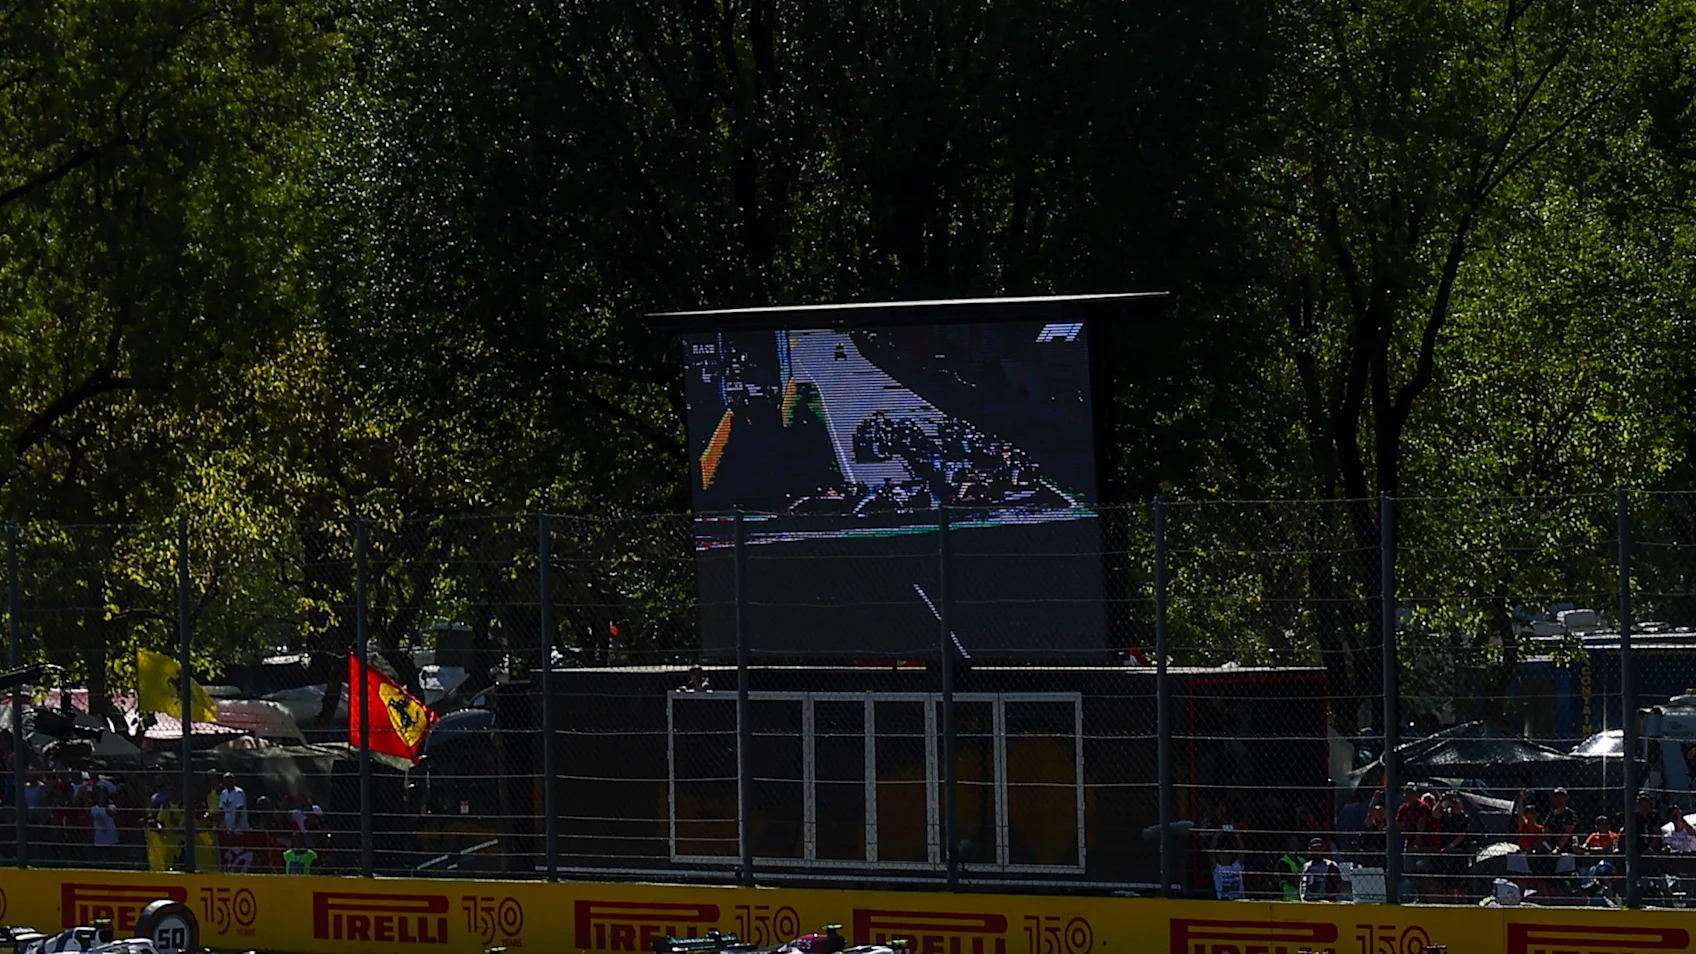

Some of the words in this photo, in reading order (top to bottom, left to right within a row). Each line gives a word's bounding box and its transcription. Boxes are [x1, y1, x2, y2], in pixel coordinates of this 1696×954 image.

[62, 883, 188, 931] PIRE
[201, 887, 257, 935] 150
[313, 892, 450, 944] PIRELLI
[462, 896, 523, 946] 150
[735, 904, 800, 948] 150
